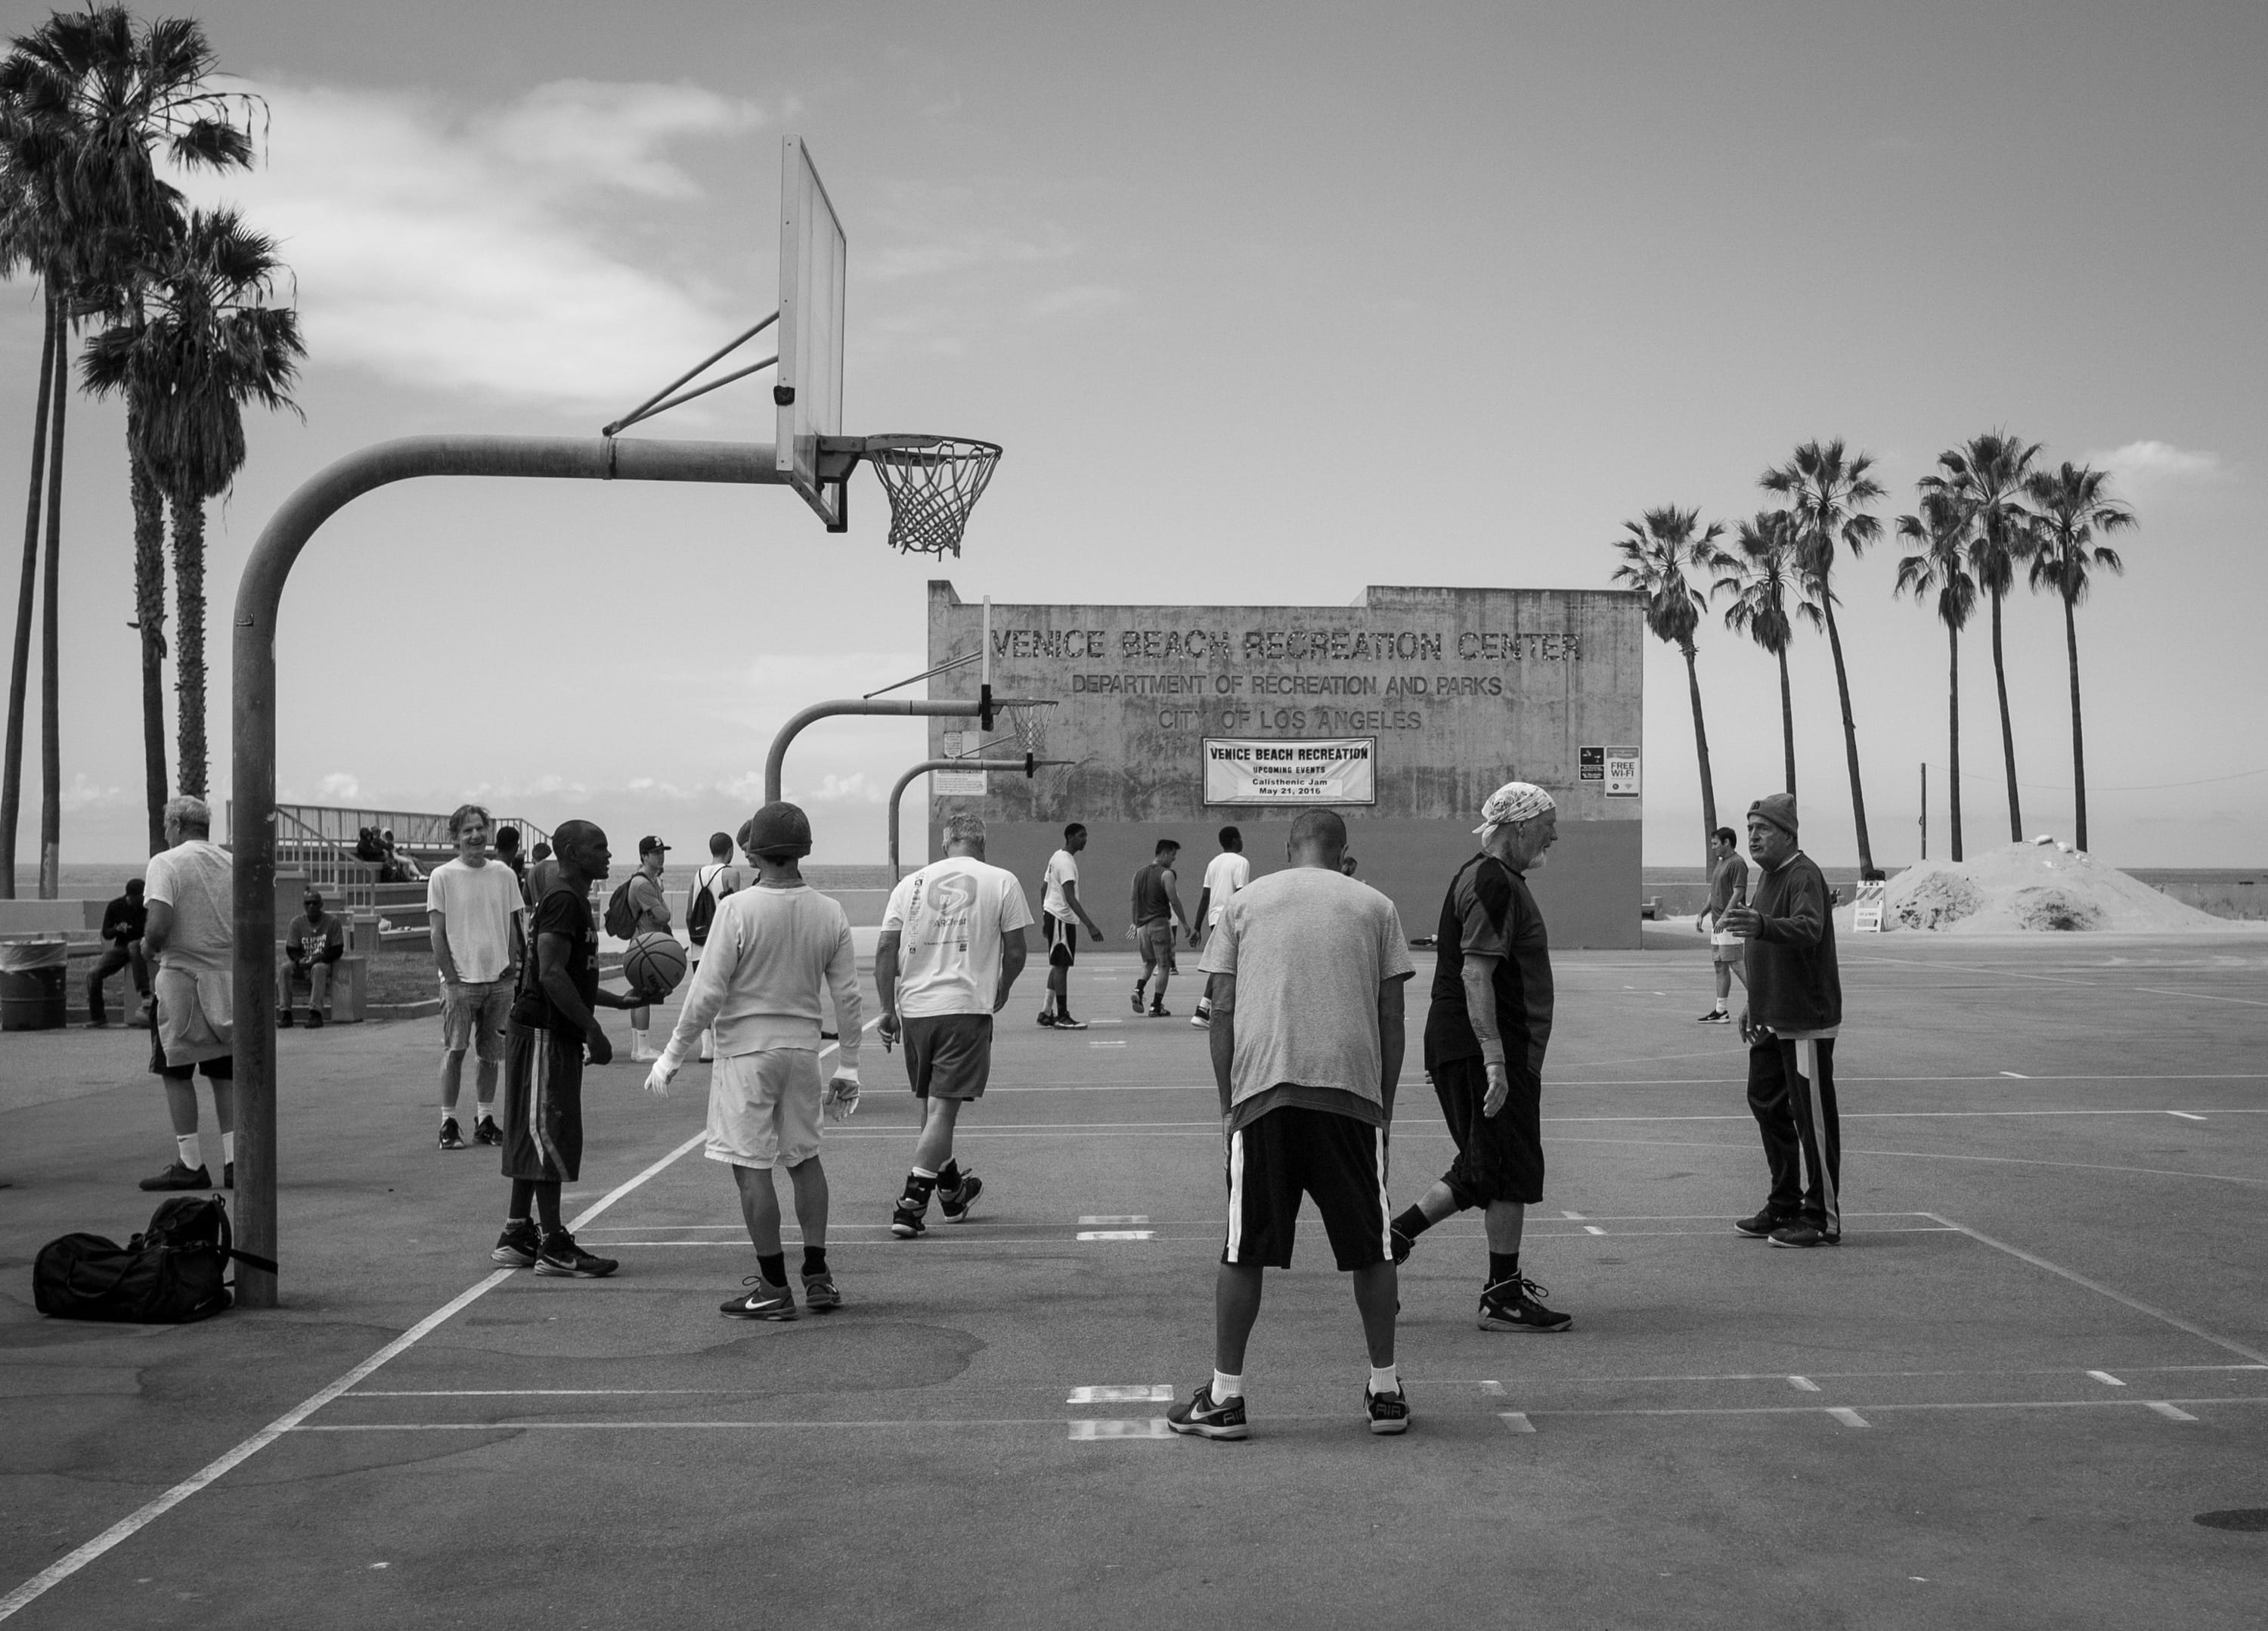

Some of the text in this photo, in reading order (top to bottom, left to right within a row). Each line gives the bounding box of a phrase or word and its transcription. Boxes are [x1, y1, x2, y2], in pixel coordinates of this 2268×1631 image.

[991, 629, 1581, 661] VENICE BEACH RECREATION CENTER
[1072, 674, 1502, 696] DEPARTMENT OF RECREATION AND PARKS
[1158, 710, 1422, 730] CITY OF LOS ANGELES
[1210, 747, 1368, 761] VENICE BEACH RECREATION
[1610, 761, 1634, 770] FREE
[1259, 787, 1278, 796] May
[1376, 1403, 1401, 1416] AIR
